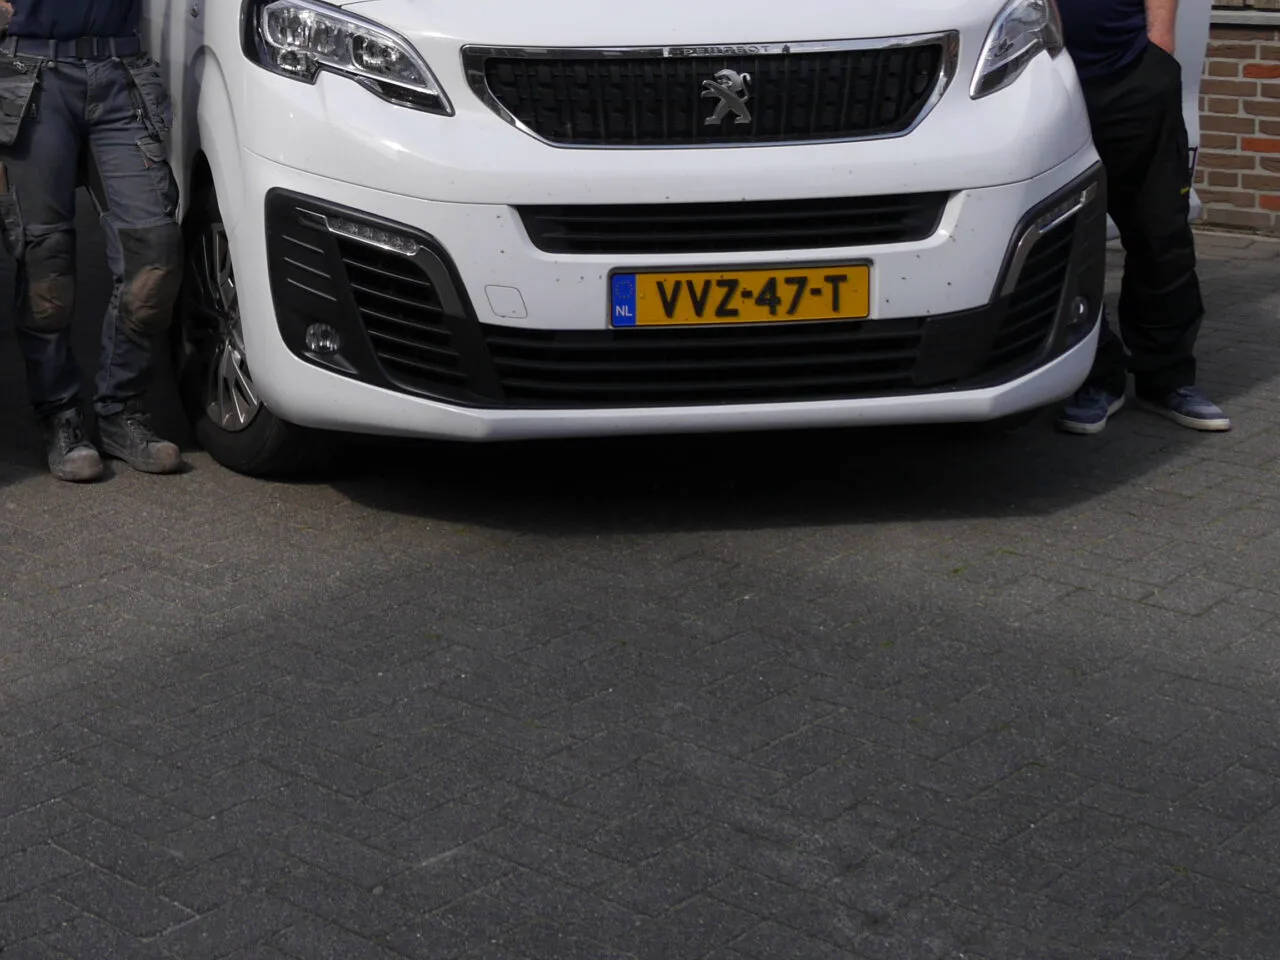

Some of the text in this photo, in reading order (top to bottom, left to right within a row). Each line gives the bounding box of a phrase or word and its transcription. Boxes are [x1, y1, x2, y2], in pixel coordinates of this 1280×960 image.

[683, 44, 770, 56] PEUGEOT
[615, 274, 848, 319] NL VVZ-47-T
